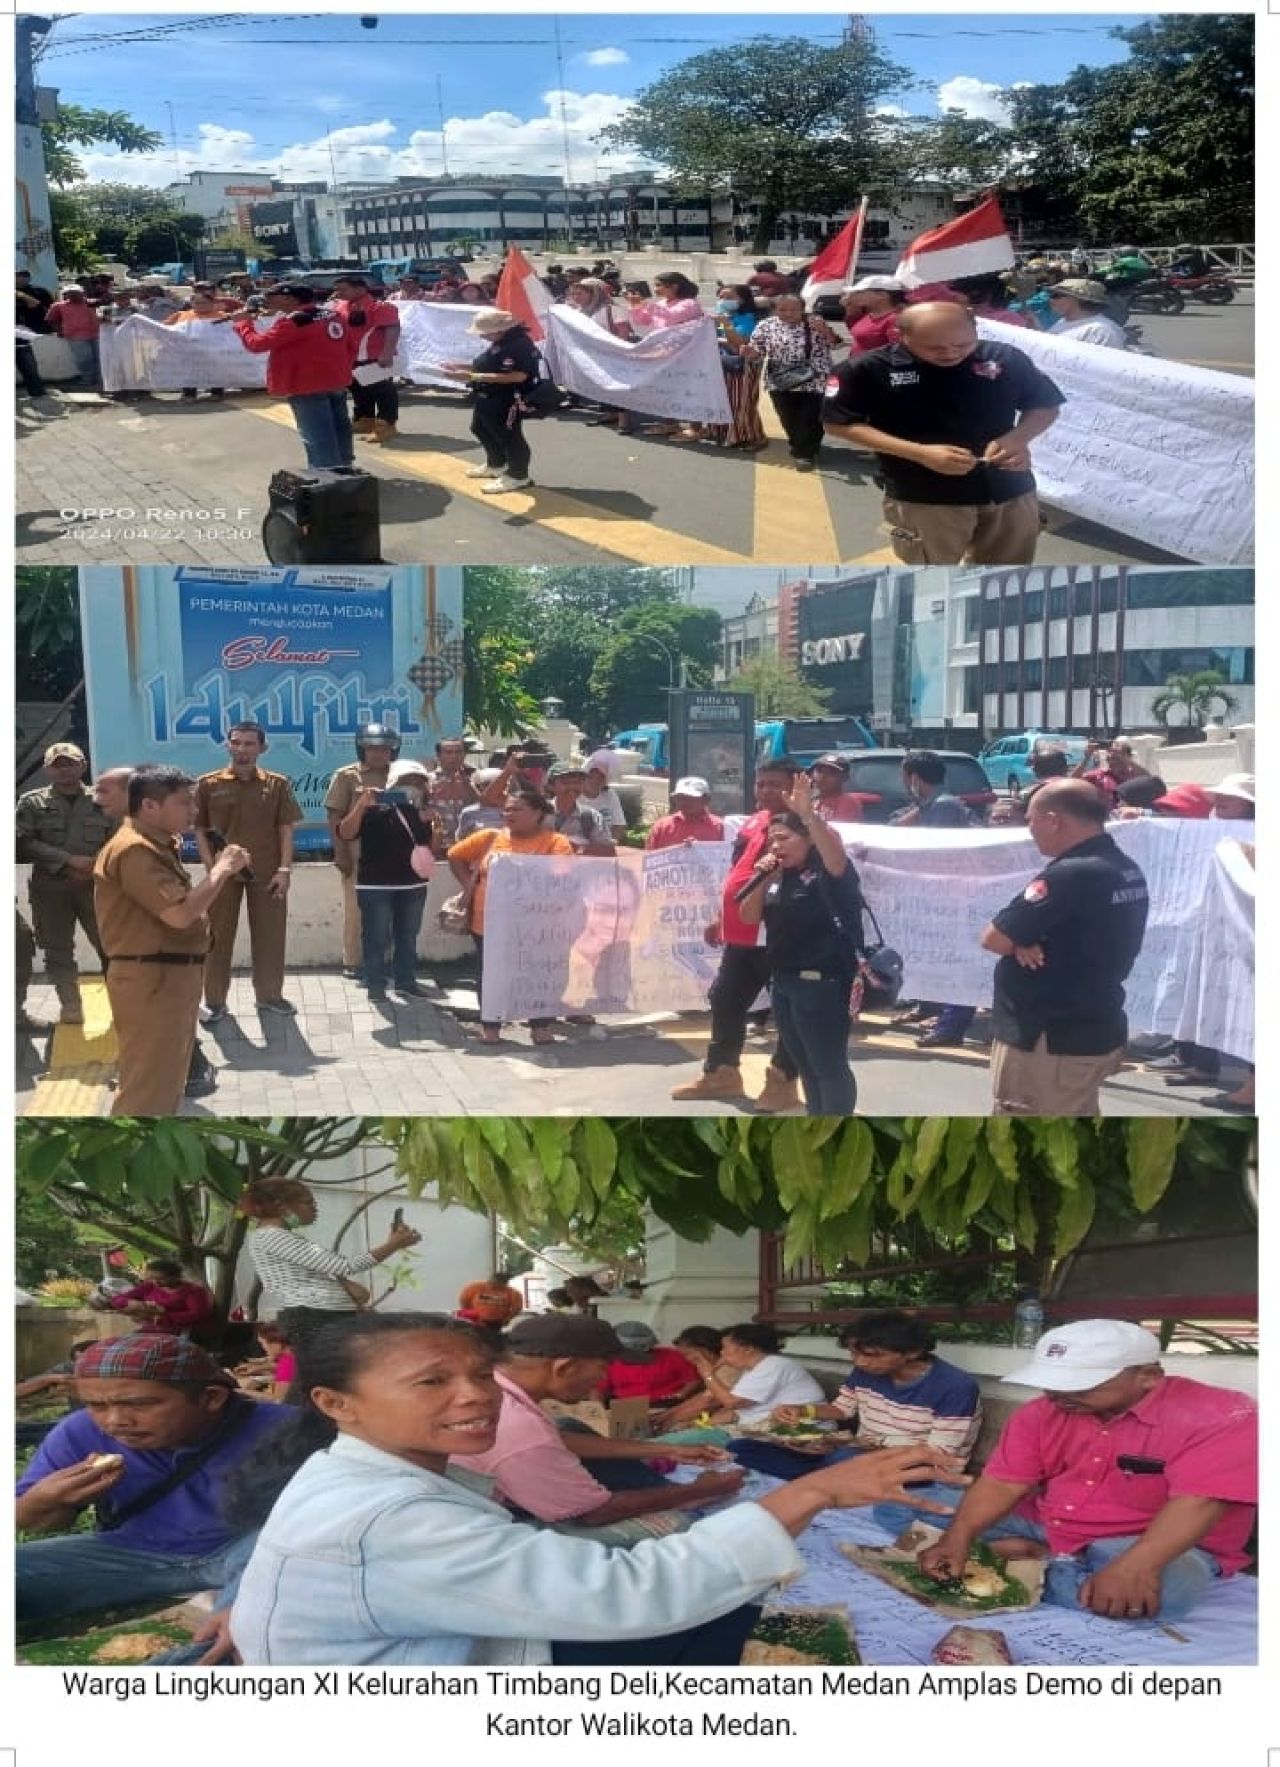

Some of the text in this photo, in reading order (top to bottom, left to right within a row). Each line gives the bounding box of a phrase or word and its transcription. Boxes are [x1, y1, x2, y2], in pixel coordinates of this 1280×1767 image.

[189, 598, 385, 619] PEMERINTAH KOTA MEDAN
[222, 635, 362, 671] Selamat
[801, 631, 866, 666] SONY
